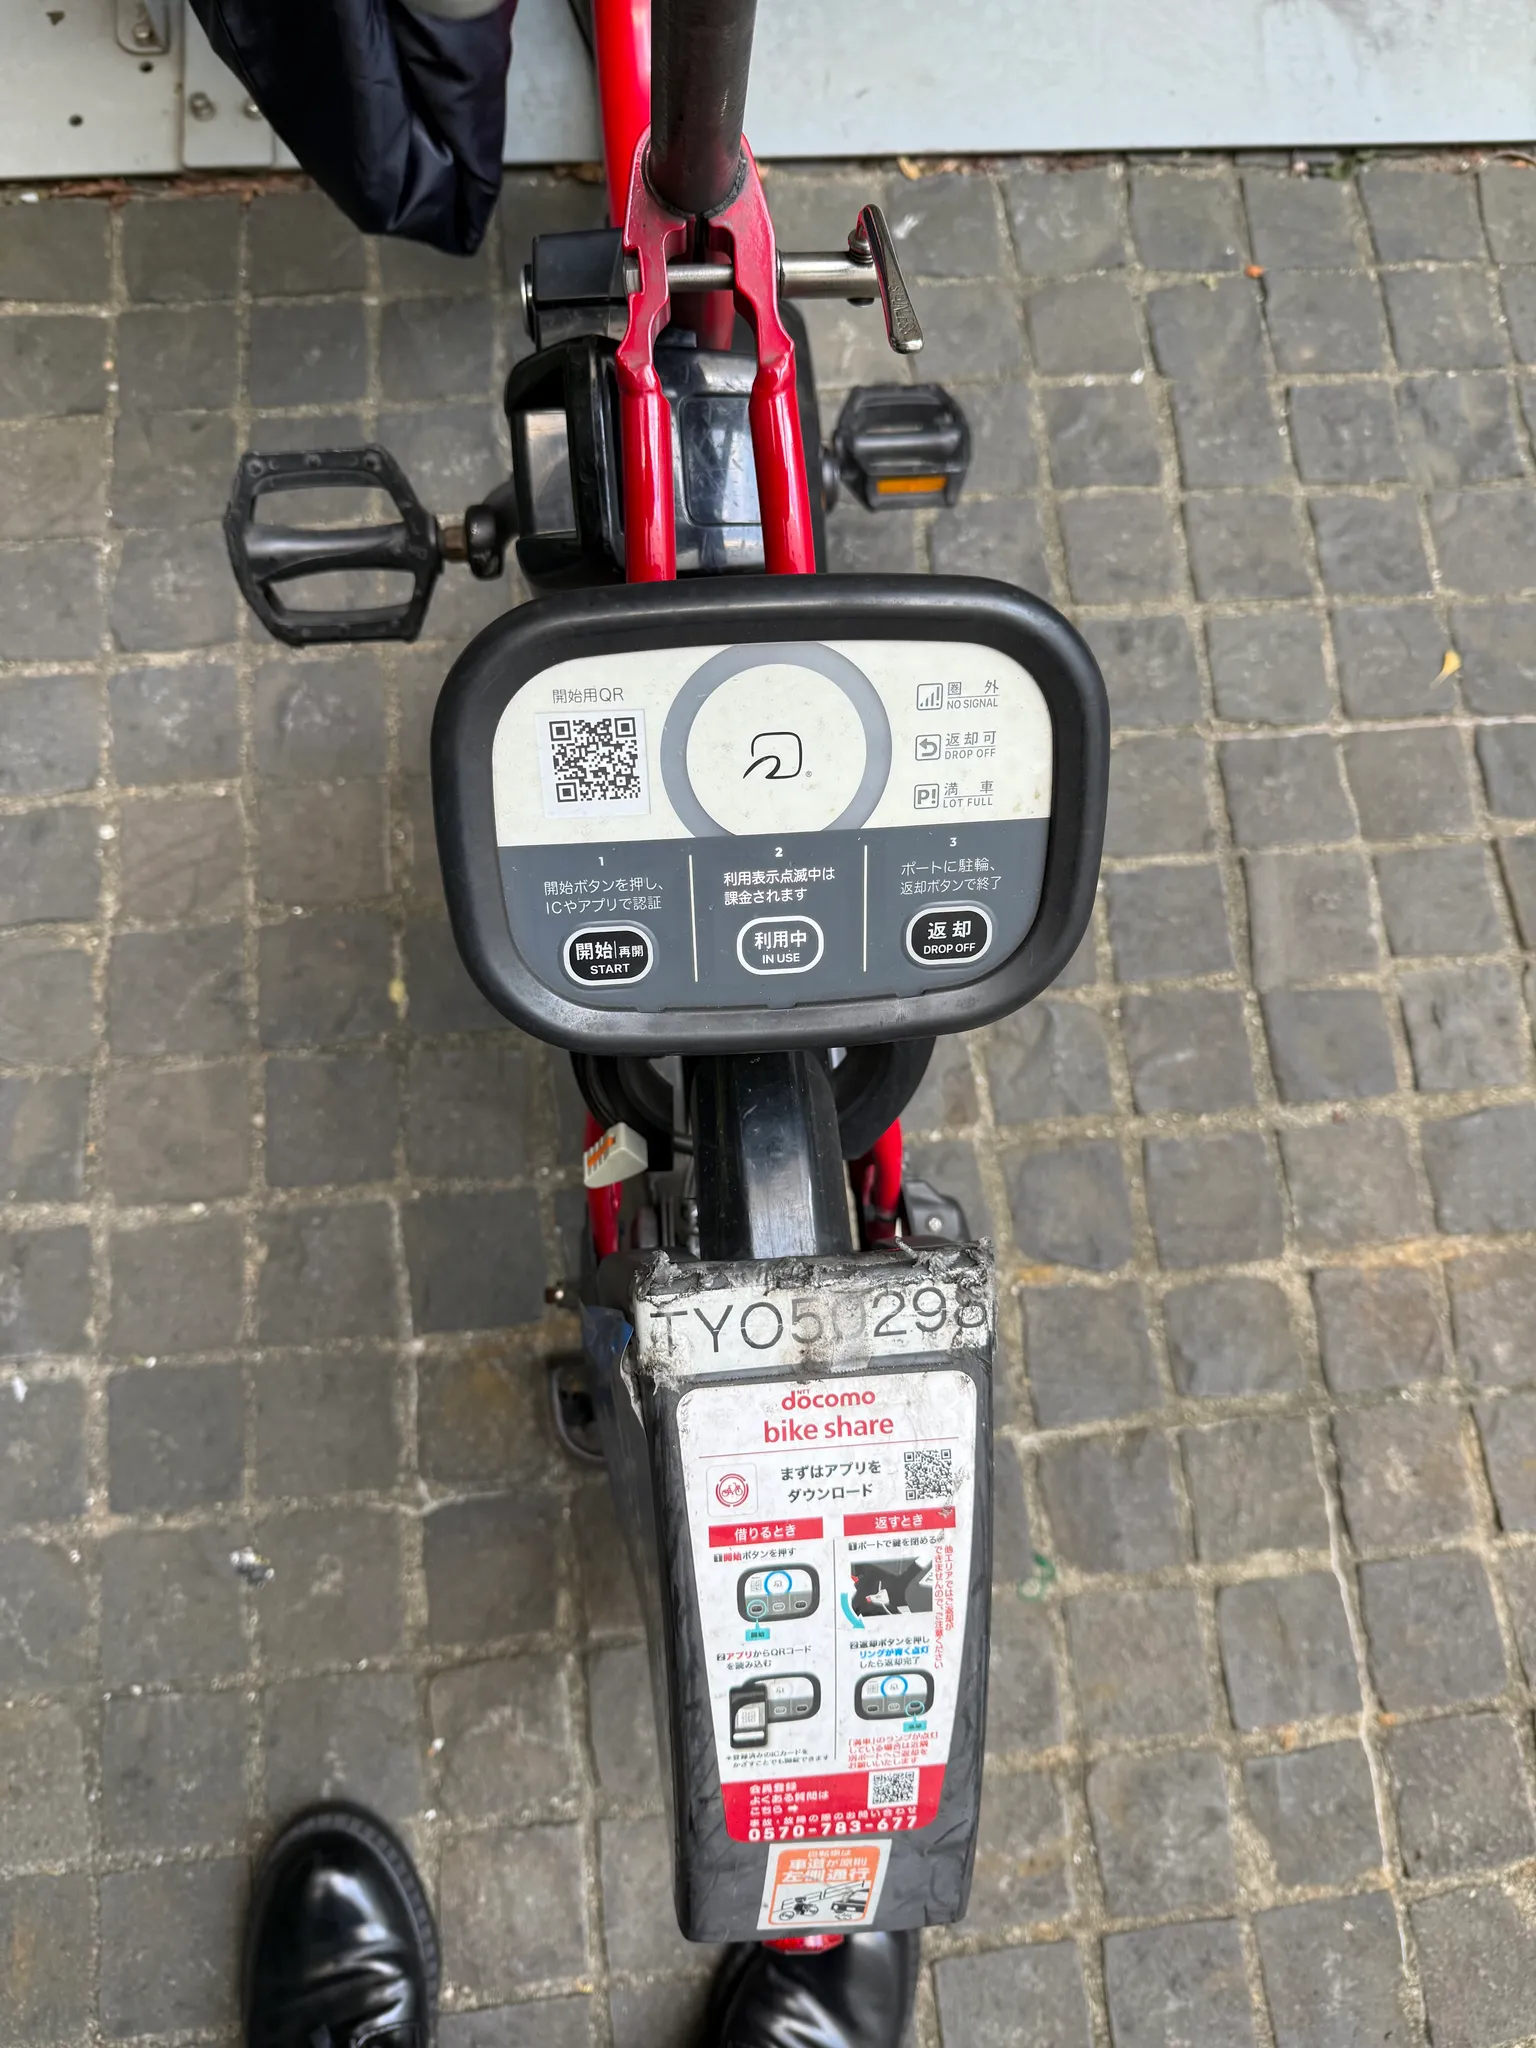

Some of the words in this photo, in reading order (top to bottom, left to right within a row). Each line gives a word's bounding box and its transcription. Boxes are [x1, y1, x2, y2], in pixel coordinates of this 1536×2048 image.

[552, 687, 624, 704] 開始用QR
[947, 699, 961, 710] NO
[964, 698, 998, 709] SIGNAL
[945, 731, 997, 747] 返却可
[945, 749, 973, 760] DROP
[976, 748, 996, 758] OFF
[943, 798, 963, 808] LOT
[967, 797, 993, 807] FULL
[949, 837, 957, 847] 3
[598, 856, 604, 867] 1
[775, 847, 783, 857] 2
[901, 857, 995, 876] ポートに駐輪、
[723, 866, 836, 887] 利用表示点滅中は
[900, 876, 1002, 895] 返却ボタンで終了
[544, 877, 664, 896] 開始ボタンを押し、
[545, 895, 662, 915] ICやアプリで認証
[724, 887, 807, 906] 課金されます
[754, 929, 807, 950] 利用中
[927, 920, 972, 940] 返却
[575, 941, 613, 960] 開始
[618, 944, 644, 959] 再開
[762, 954, 774, 964] IN
[777, 953, 800, 964] USE
[923, 944, 954, 955] DROP
[955, 943, 976, 953] OFF
[590, 963, 630, 975] START
[781, 1390, 876, 1411] docomo
[764, 1418, 818, 1443] bike
[823, 1414, 894, 1439] share
[781, 1460, 881, 1481] まずはアプリを
[788, 1483, 873, 1503] ダウンロード
[875, 1514, 923, 1529] 返すとき
[734, 1524, 796, 1543] 借りるとき
[748, 1815, 918, 1841] 0570-783-677
